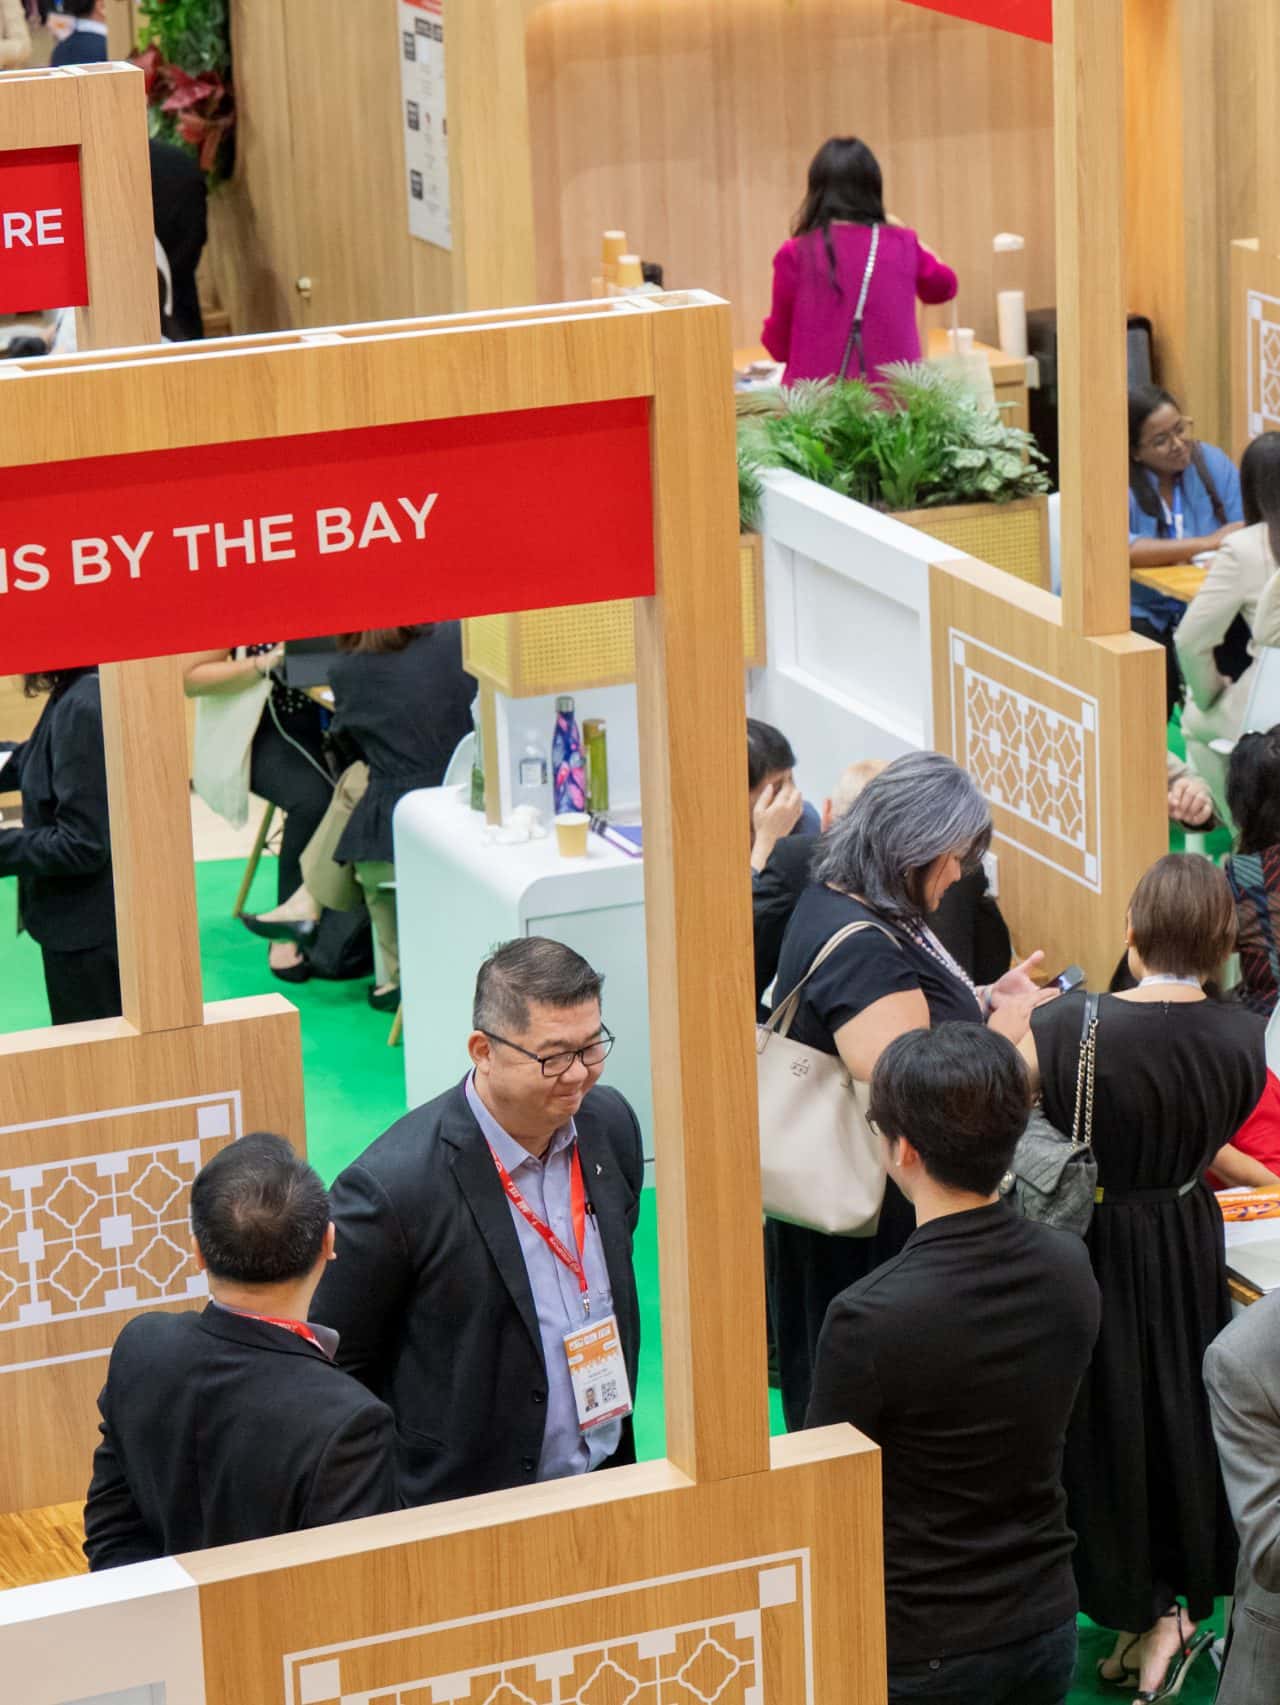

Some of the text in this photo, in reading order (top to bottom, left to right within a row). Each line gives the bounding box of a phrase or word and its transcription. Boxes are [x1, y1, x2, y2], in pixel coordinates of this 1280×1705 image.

[3, 209, 64, 248] RE
[0, 494, 437, 593] S BY THE BAY
